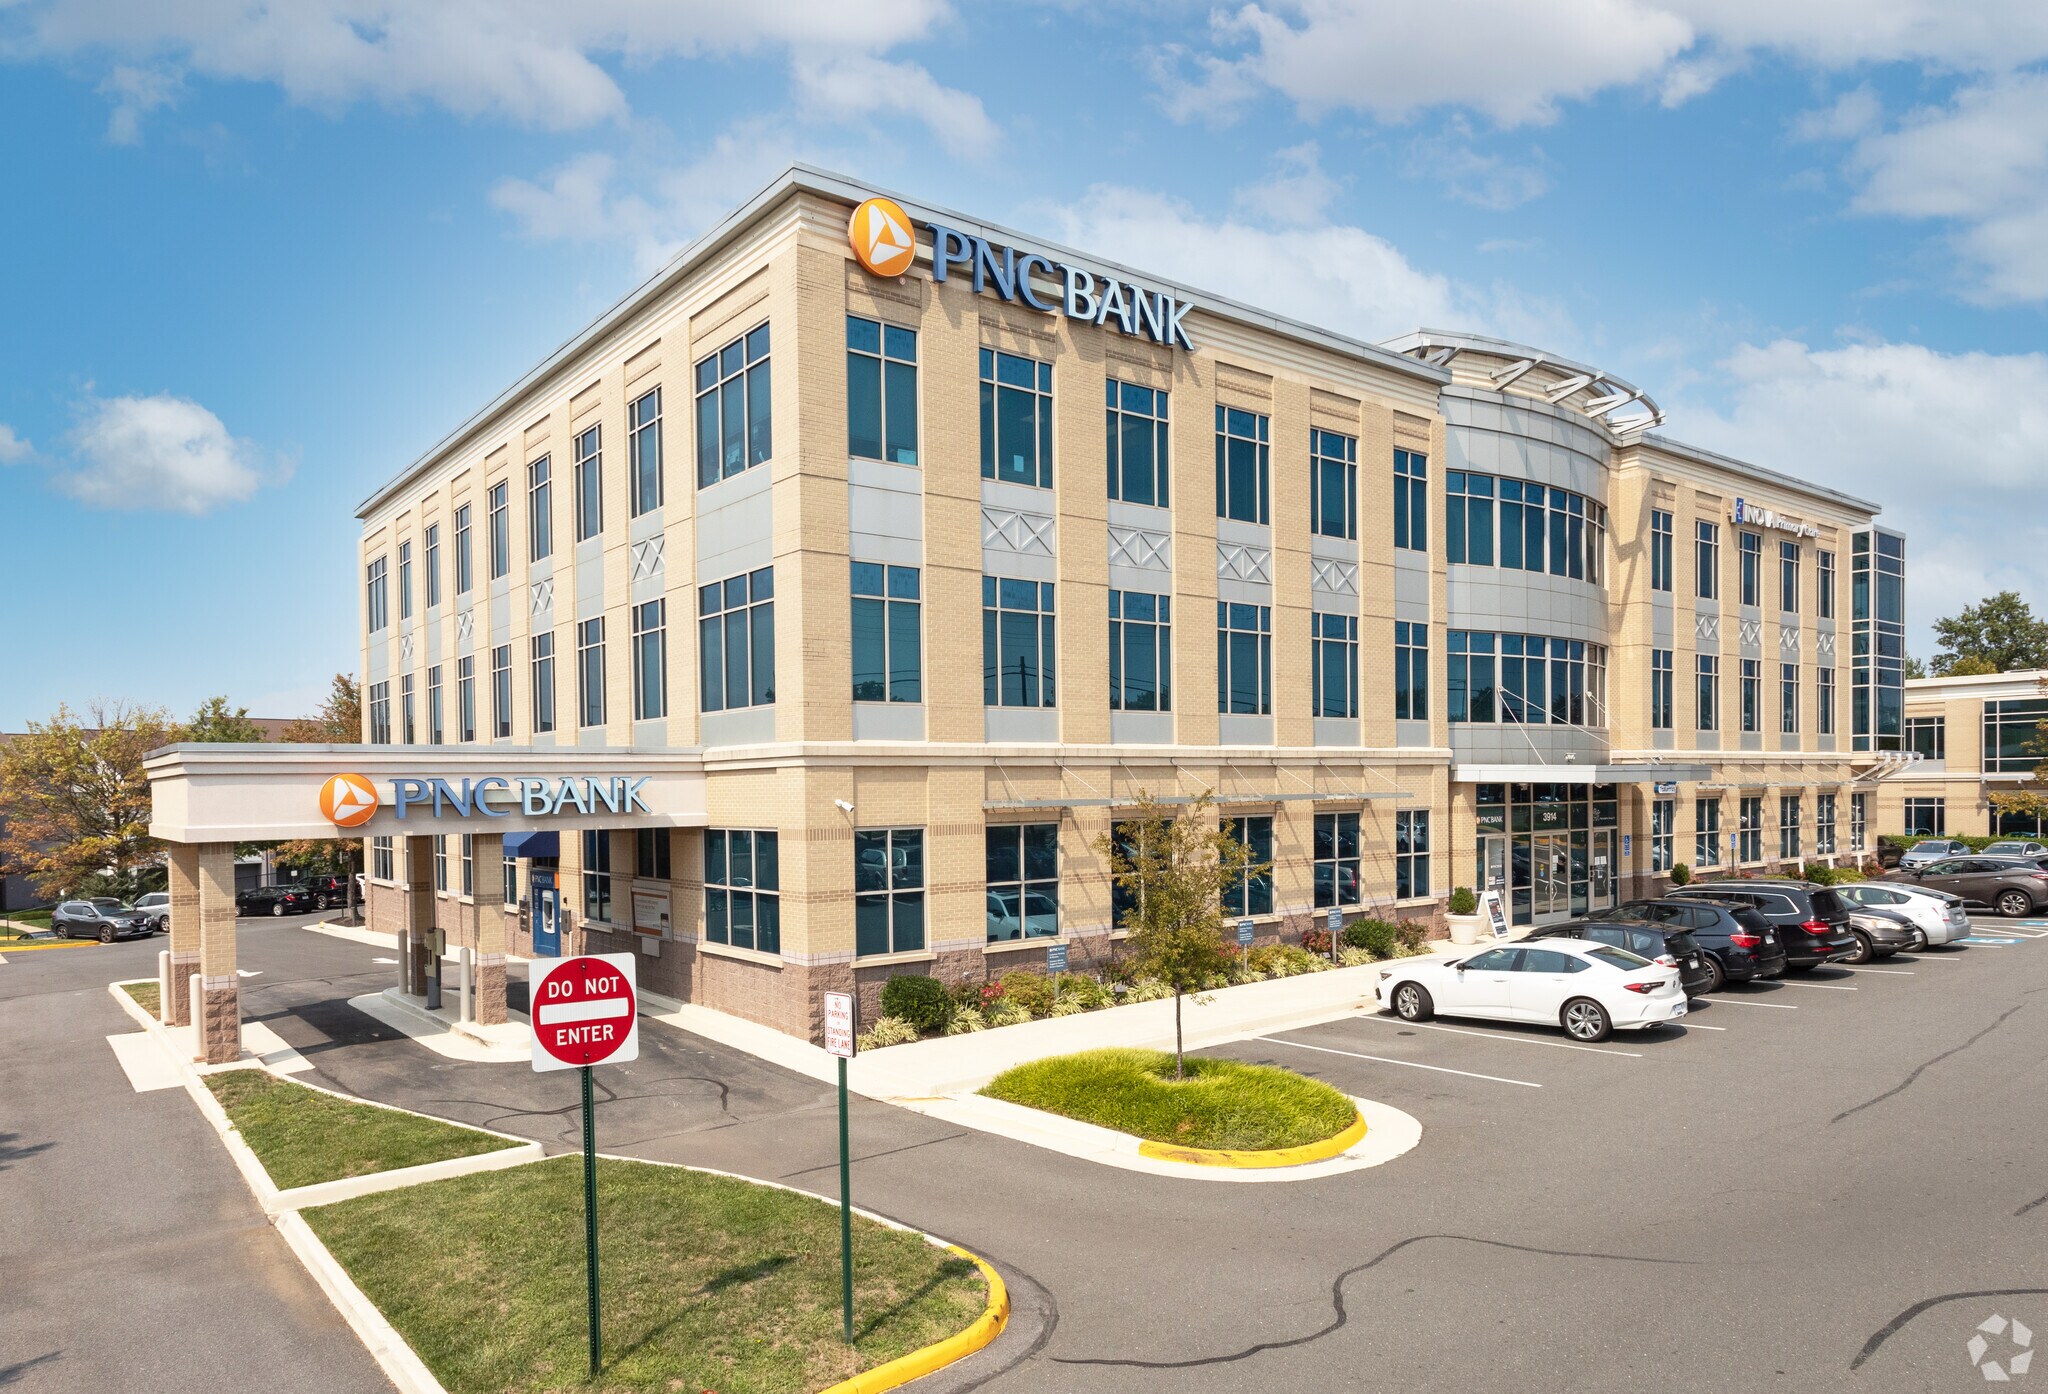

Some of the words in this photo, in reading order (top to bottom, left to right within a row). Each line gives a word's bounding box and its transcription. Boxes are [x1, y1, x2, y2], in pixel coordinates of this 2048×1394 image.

[926, 222, 1055, 312] PNC
[1055, 262, 1195, 352] BANK
[387, 777, 510, 819] PNC
[514, 776, 653, 816] BANK
[1480, 816, 1491, 824] PNC
[1542, 812, 1557, 822] 3914
[548, 980, 573, 998] DO
[585, 976, 620, 995] NOT
[834, 1001, 841, 1009] NO
[828, 1010, 849, 1020] PARKING
[556, 1024, 614, 1046] ENTER
[827, 1026, 850, 1038] STANDING
[827, 1037, 837, 1048] FIRE
[838, 1039, 850, 1050] LANE
